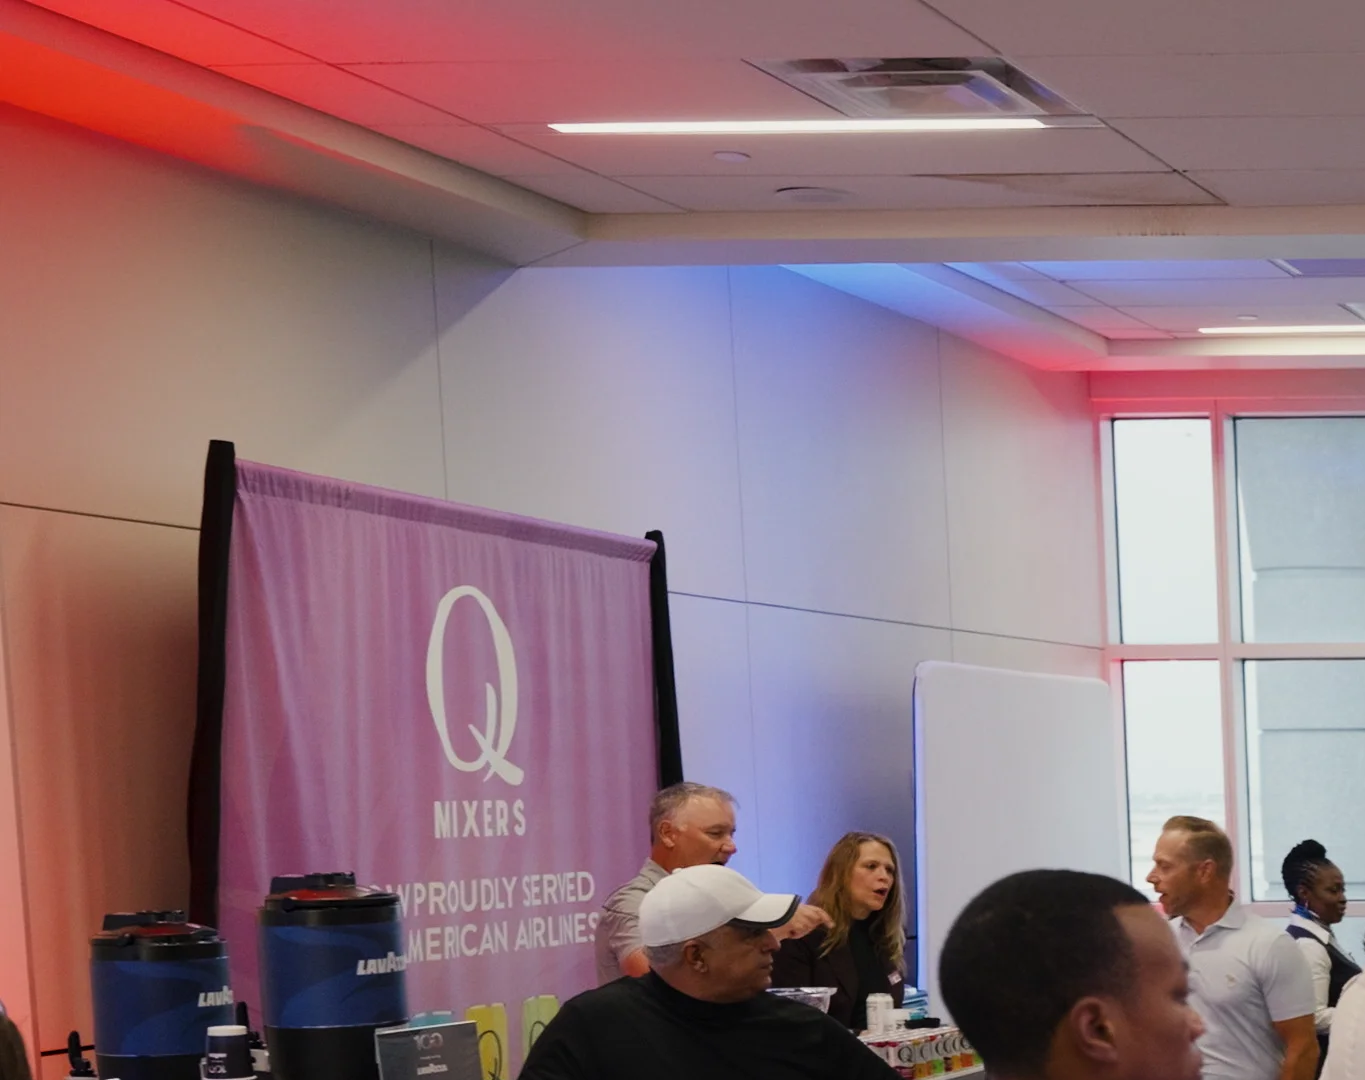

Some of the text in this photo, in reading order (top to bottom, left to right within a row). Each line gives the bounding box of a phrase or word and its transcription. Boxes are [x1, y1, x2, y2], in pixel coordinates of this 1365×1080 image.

[426, 585, 524, 786] Q
[433, 798, 527, 839] MIXERS
[522, 871, 596, 907] SERVED
[404, 917, 509, 964] MERICAN
